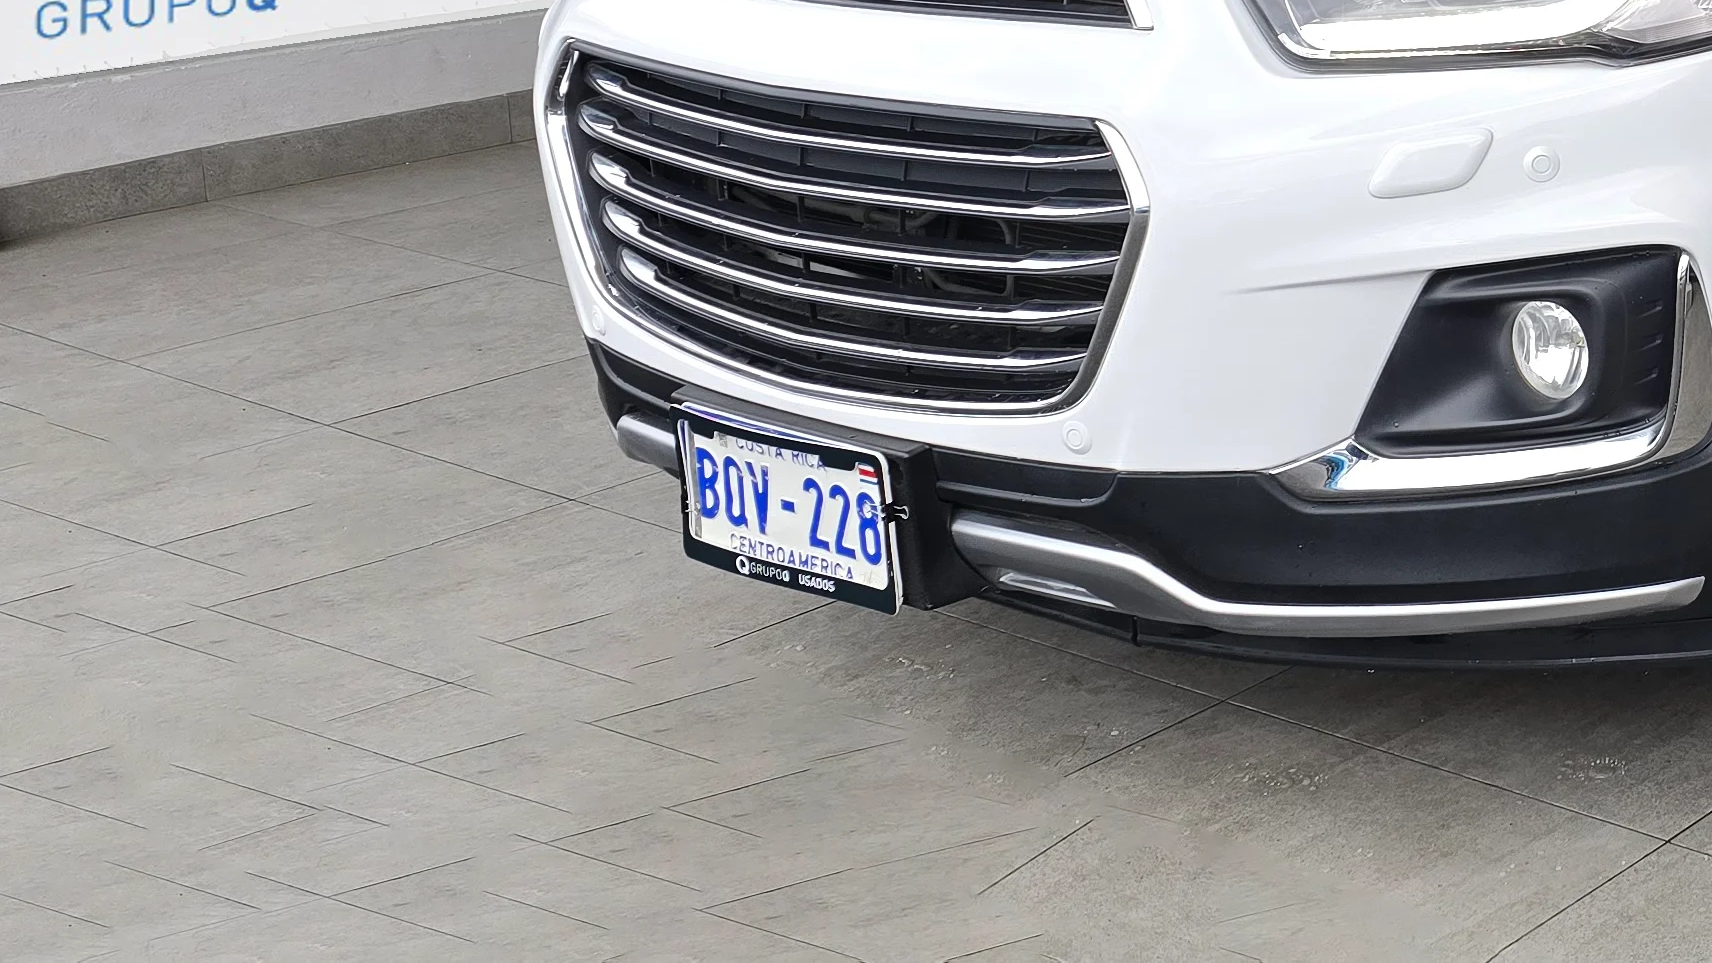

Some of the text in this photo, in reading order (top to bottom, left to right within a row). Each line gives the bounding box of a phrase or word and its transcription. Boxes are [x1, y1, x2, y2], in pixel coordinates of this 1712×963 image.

[696, 447, 882, 565] BQV-228
[730, 532, 855, 580] CENTROAMERICA
[798, 573, 835, 592] USADOS
